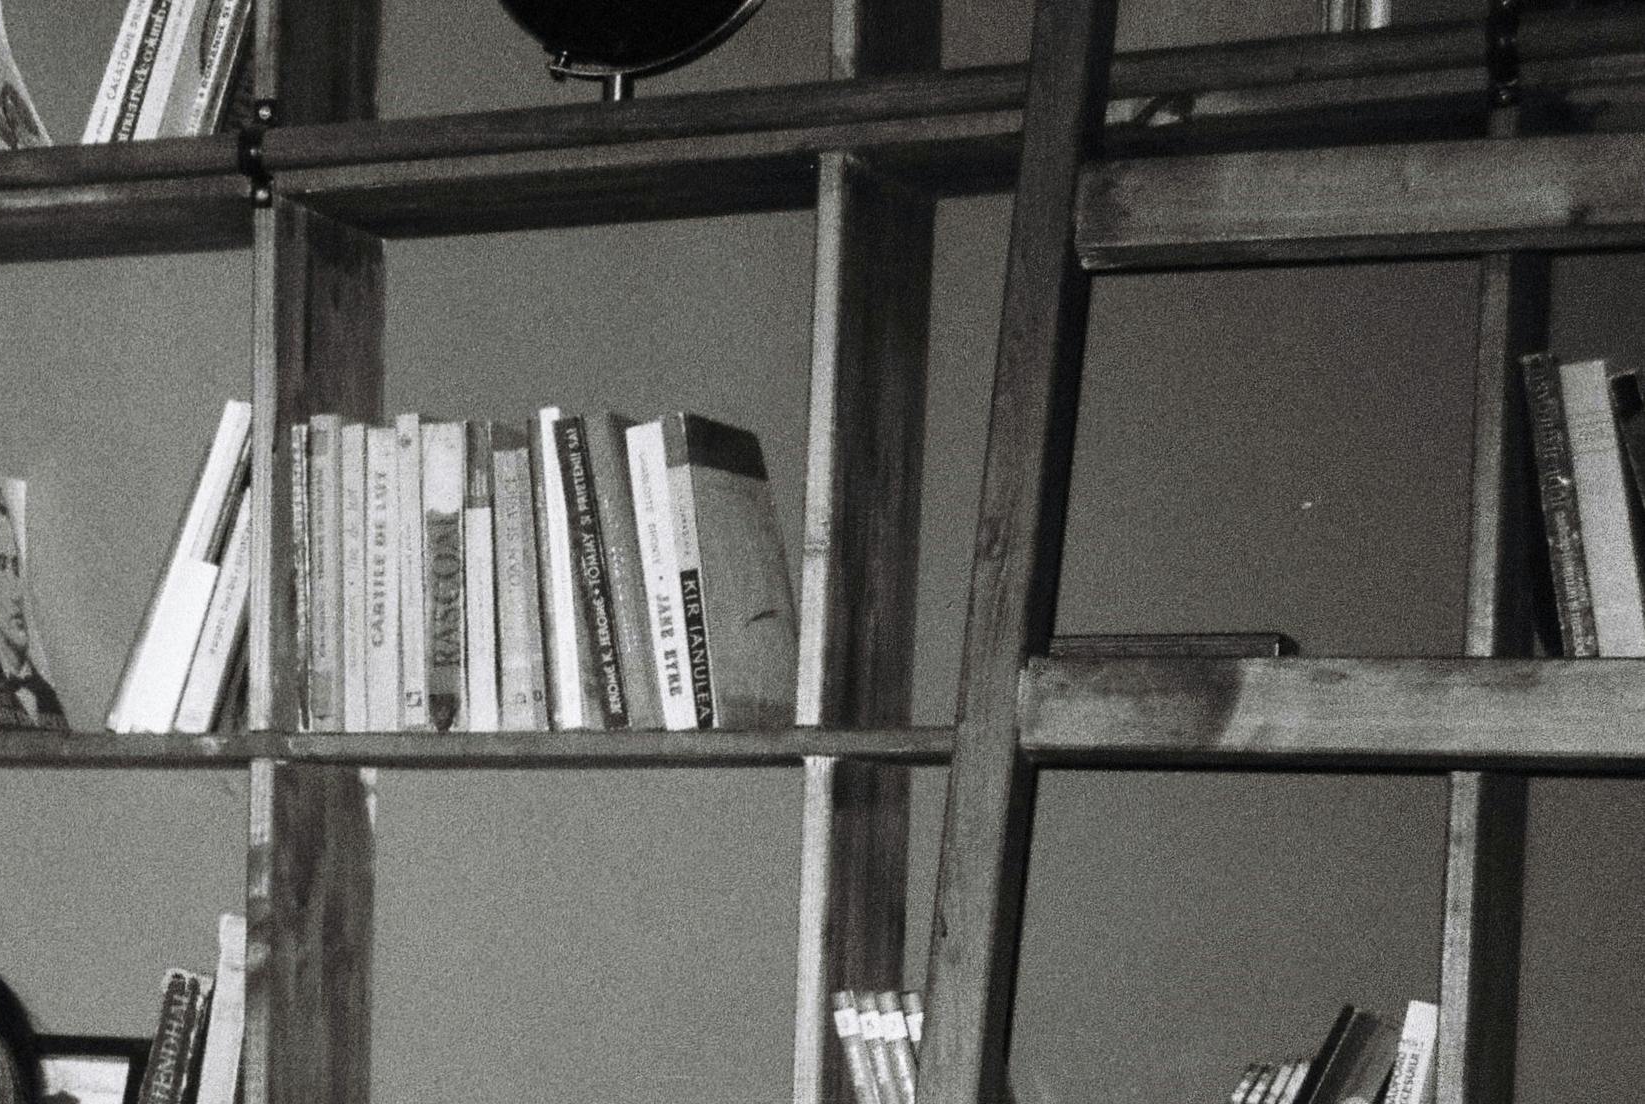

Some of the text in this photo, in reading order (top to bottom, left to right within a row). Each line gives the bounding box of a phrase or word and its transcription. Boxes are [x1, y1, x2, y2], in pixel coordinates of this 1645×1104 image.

[582, 531, 602, 586] TOMMY
[594, 596, 613, 648] JEROME
[655, 593, 675, 640] JANE
[682, 578, 701, 617] KIR
[604, 665, 623, 715] JEROME
[663, 649, 683, 697] EYRE
[688, 625, 713, 720] IANULEA
